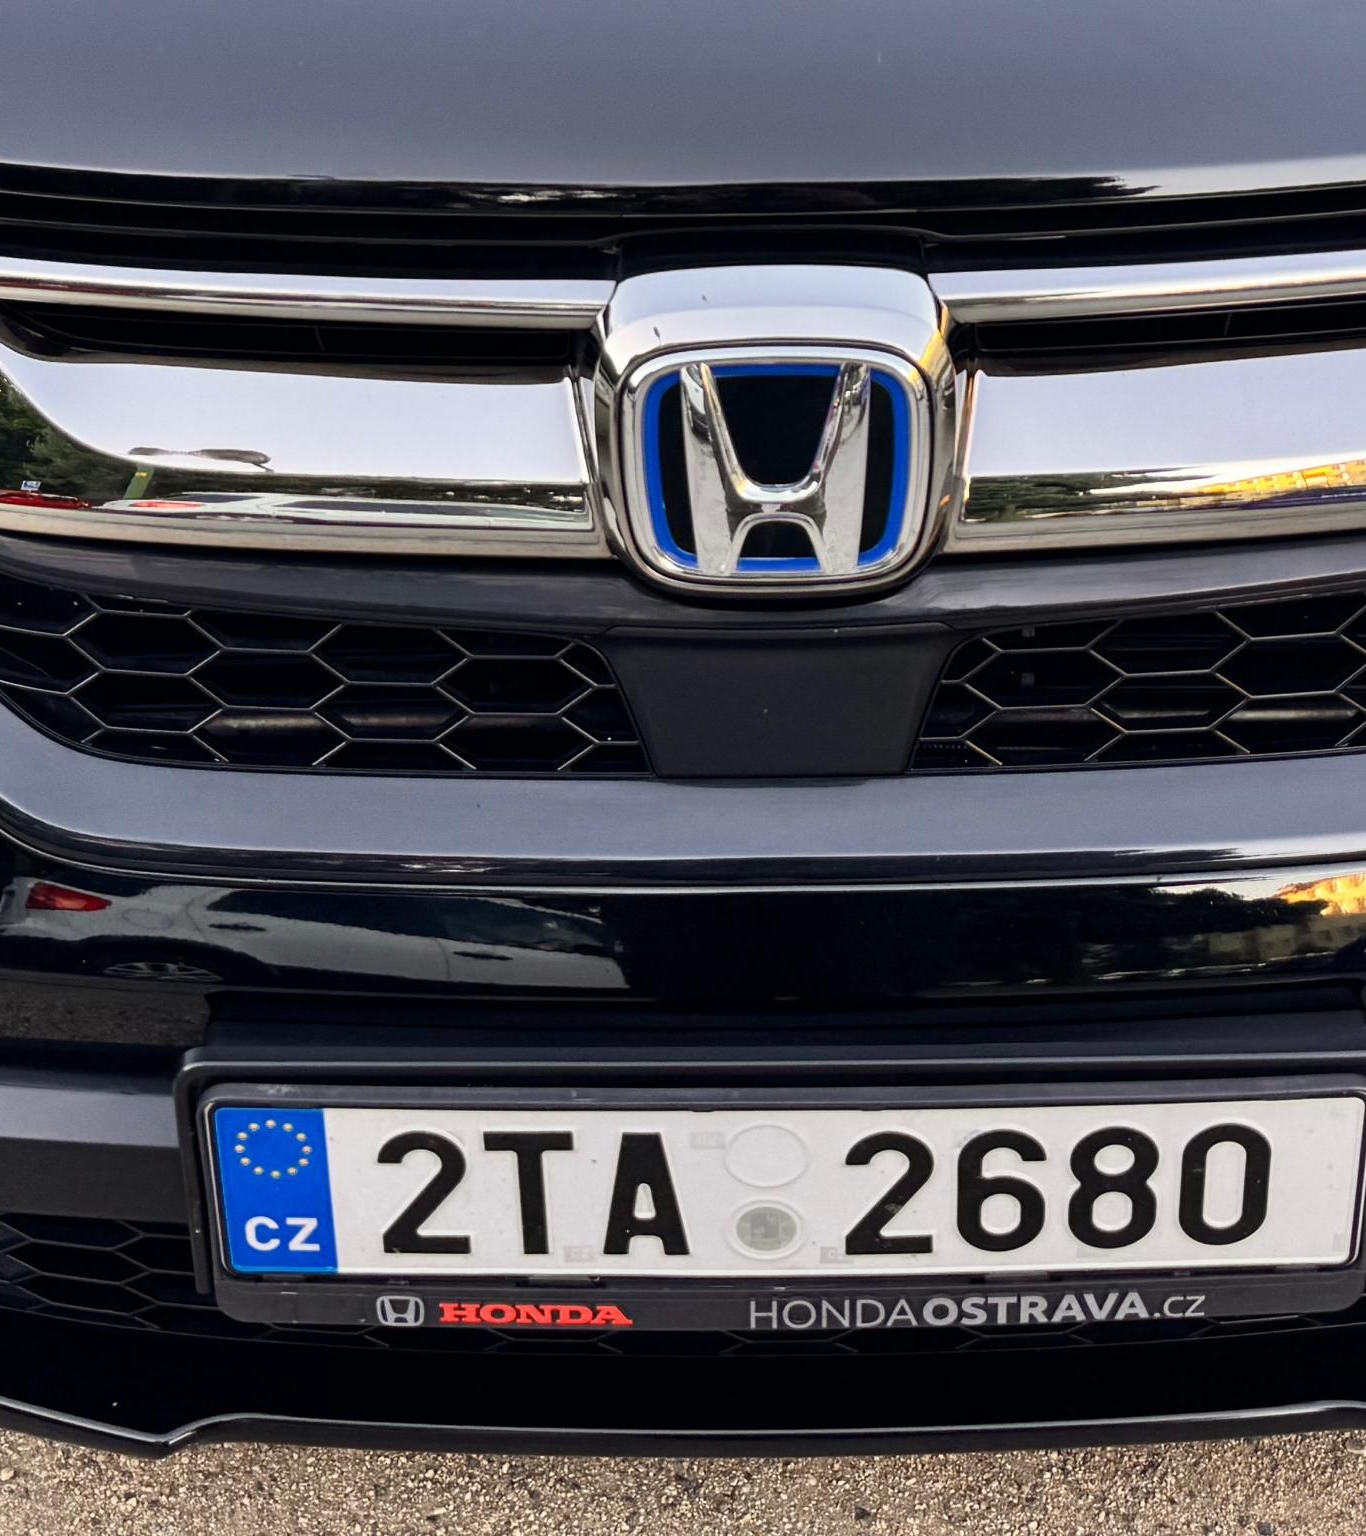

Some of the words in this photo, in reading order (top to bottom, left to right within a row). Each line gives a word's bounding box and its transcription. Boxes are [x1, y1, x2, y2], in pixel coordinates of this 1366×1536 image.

[376, 1130, 690, 1256] 2TA
[844, 1121, 1273, 1256] 2680
[244, 1215, 321, 1253] CZ
[439, 1301, 633, 1327] HONDA
